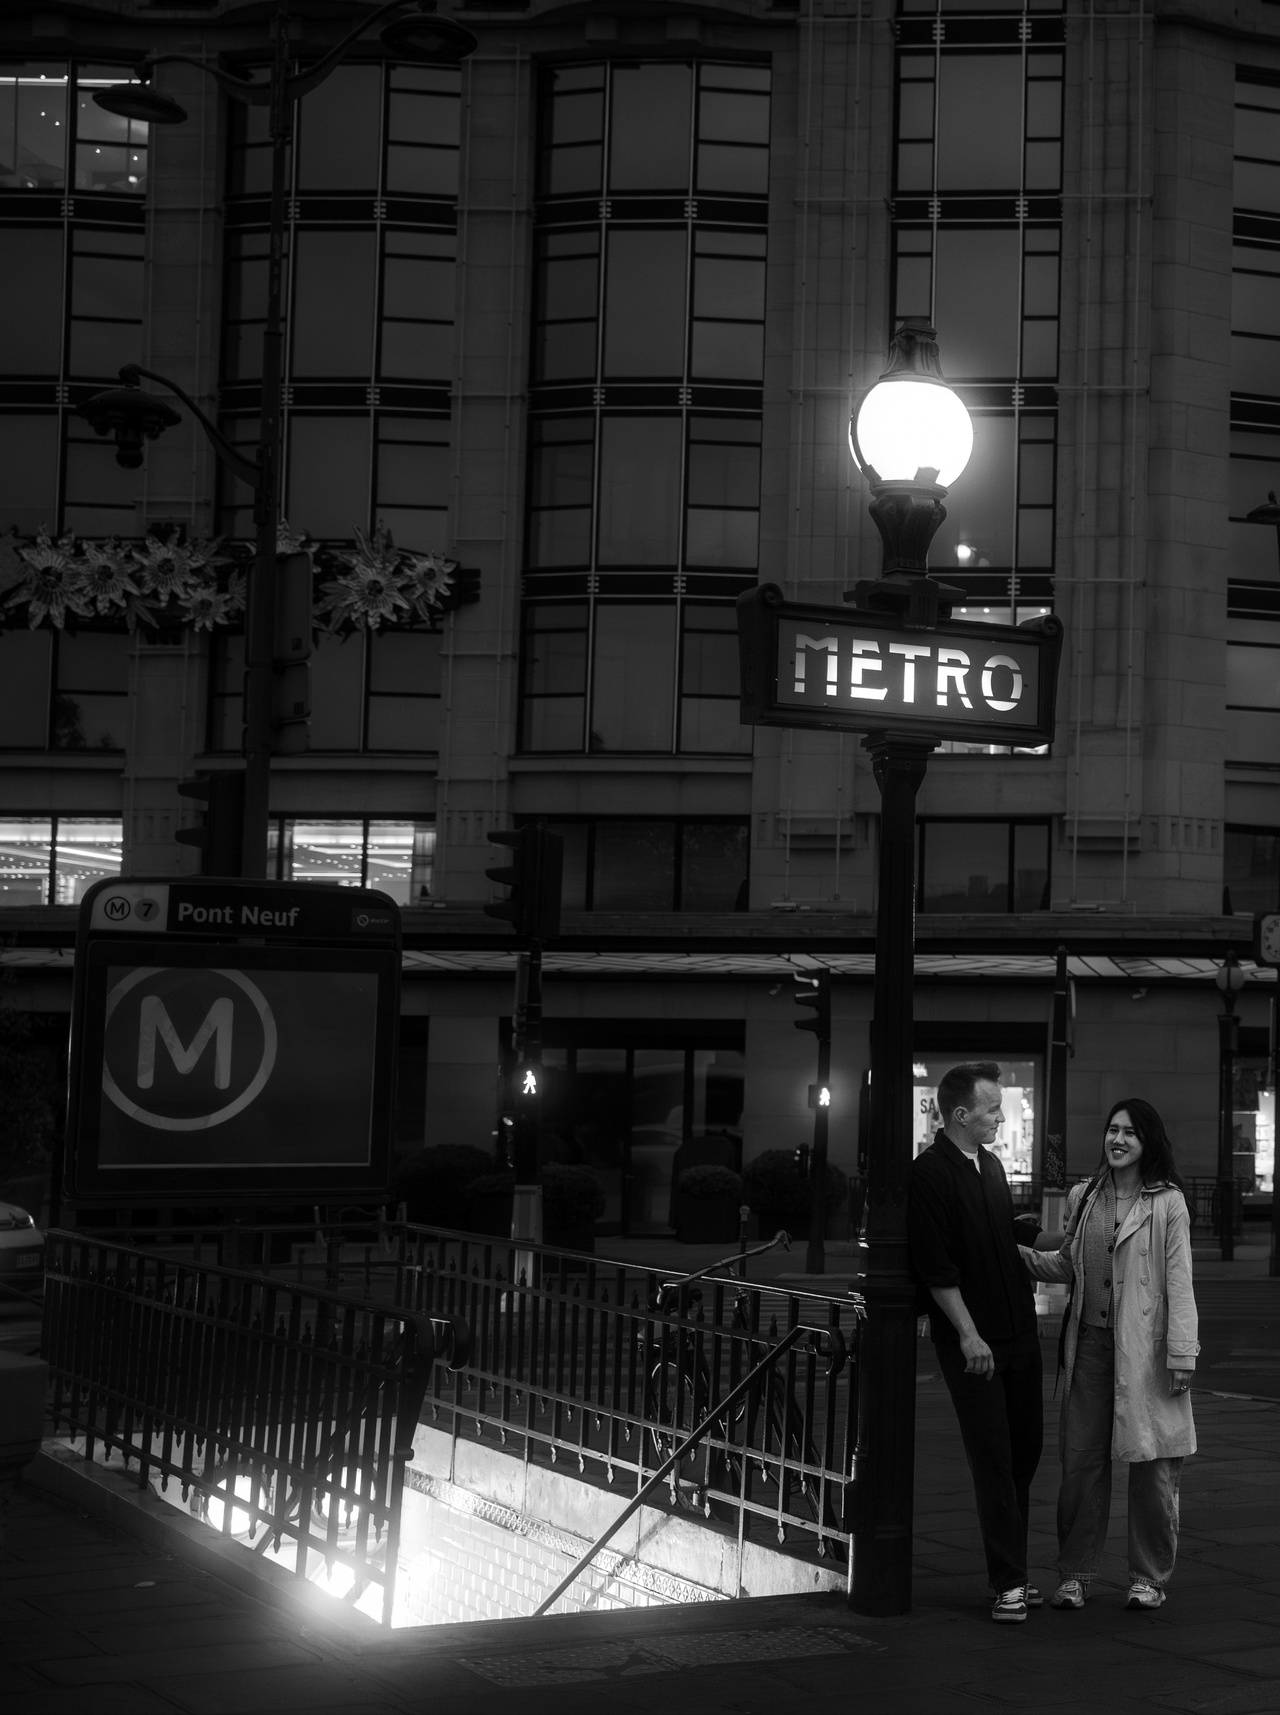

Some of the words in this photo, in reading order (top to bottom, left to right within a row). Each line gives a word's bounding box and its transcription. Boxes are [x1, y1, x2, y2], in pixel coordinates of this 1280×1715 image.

[793, 633, 1023, 712] METRO
[142, 903, 153, 917] 7
[178, 902, 233, 925] Pont
[241, 905, 301, 927] Neuf
[136, 995, 234, 1090] M
